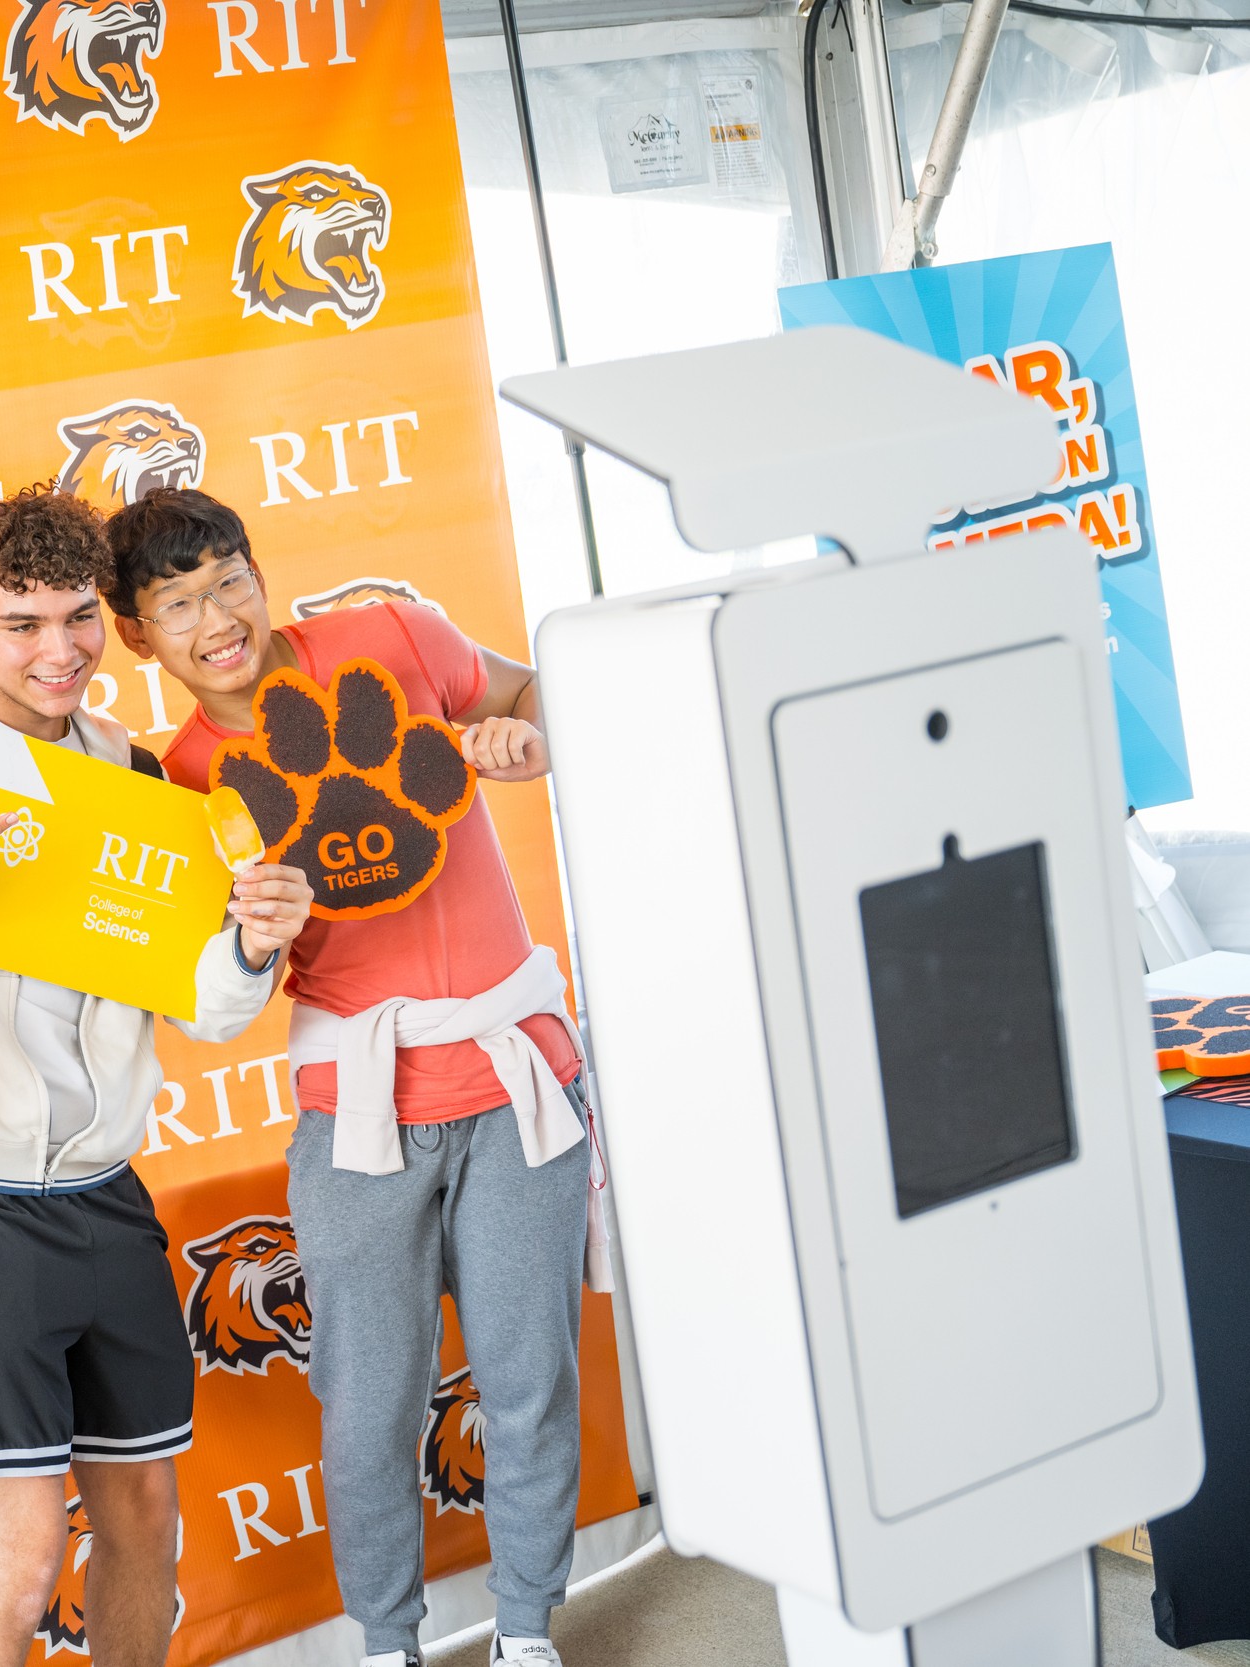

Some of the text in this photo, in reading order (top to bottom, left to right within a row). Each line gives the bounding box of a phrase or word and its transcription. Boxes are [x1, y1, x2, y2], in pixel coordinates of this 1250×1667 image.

[207, 0, 366, 78] RIT
[19, 225, 189, 322] RIT
[248, 410, 420, 509] RIT
[80, 661, 178, 738] RI
[92, 831, 190, 895] RIT
[317, 823, 395, 870] GO
[323, 861, 400, 891] TIGERS
[83, 911, 151, 946] Science
[88, 894, 145, 921] College of
[141, 1052, 294, 1157] RIT
[216, 1460, 326, 1562] RI
[521, 1644, 548, 1654] adidas
